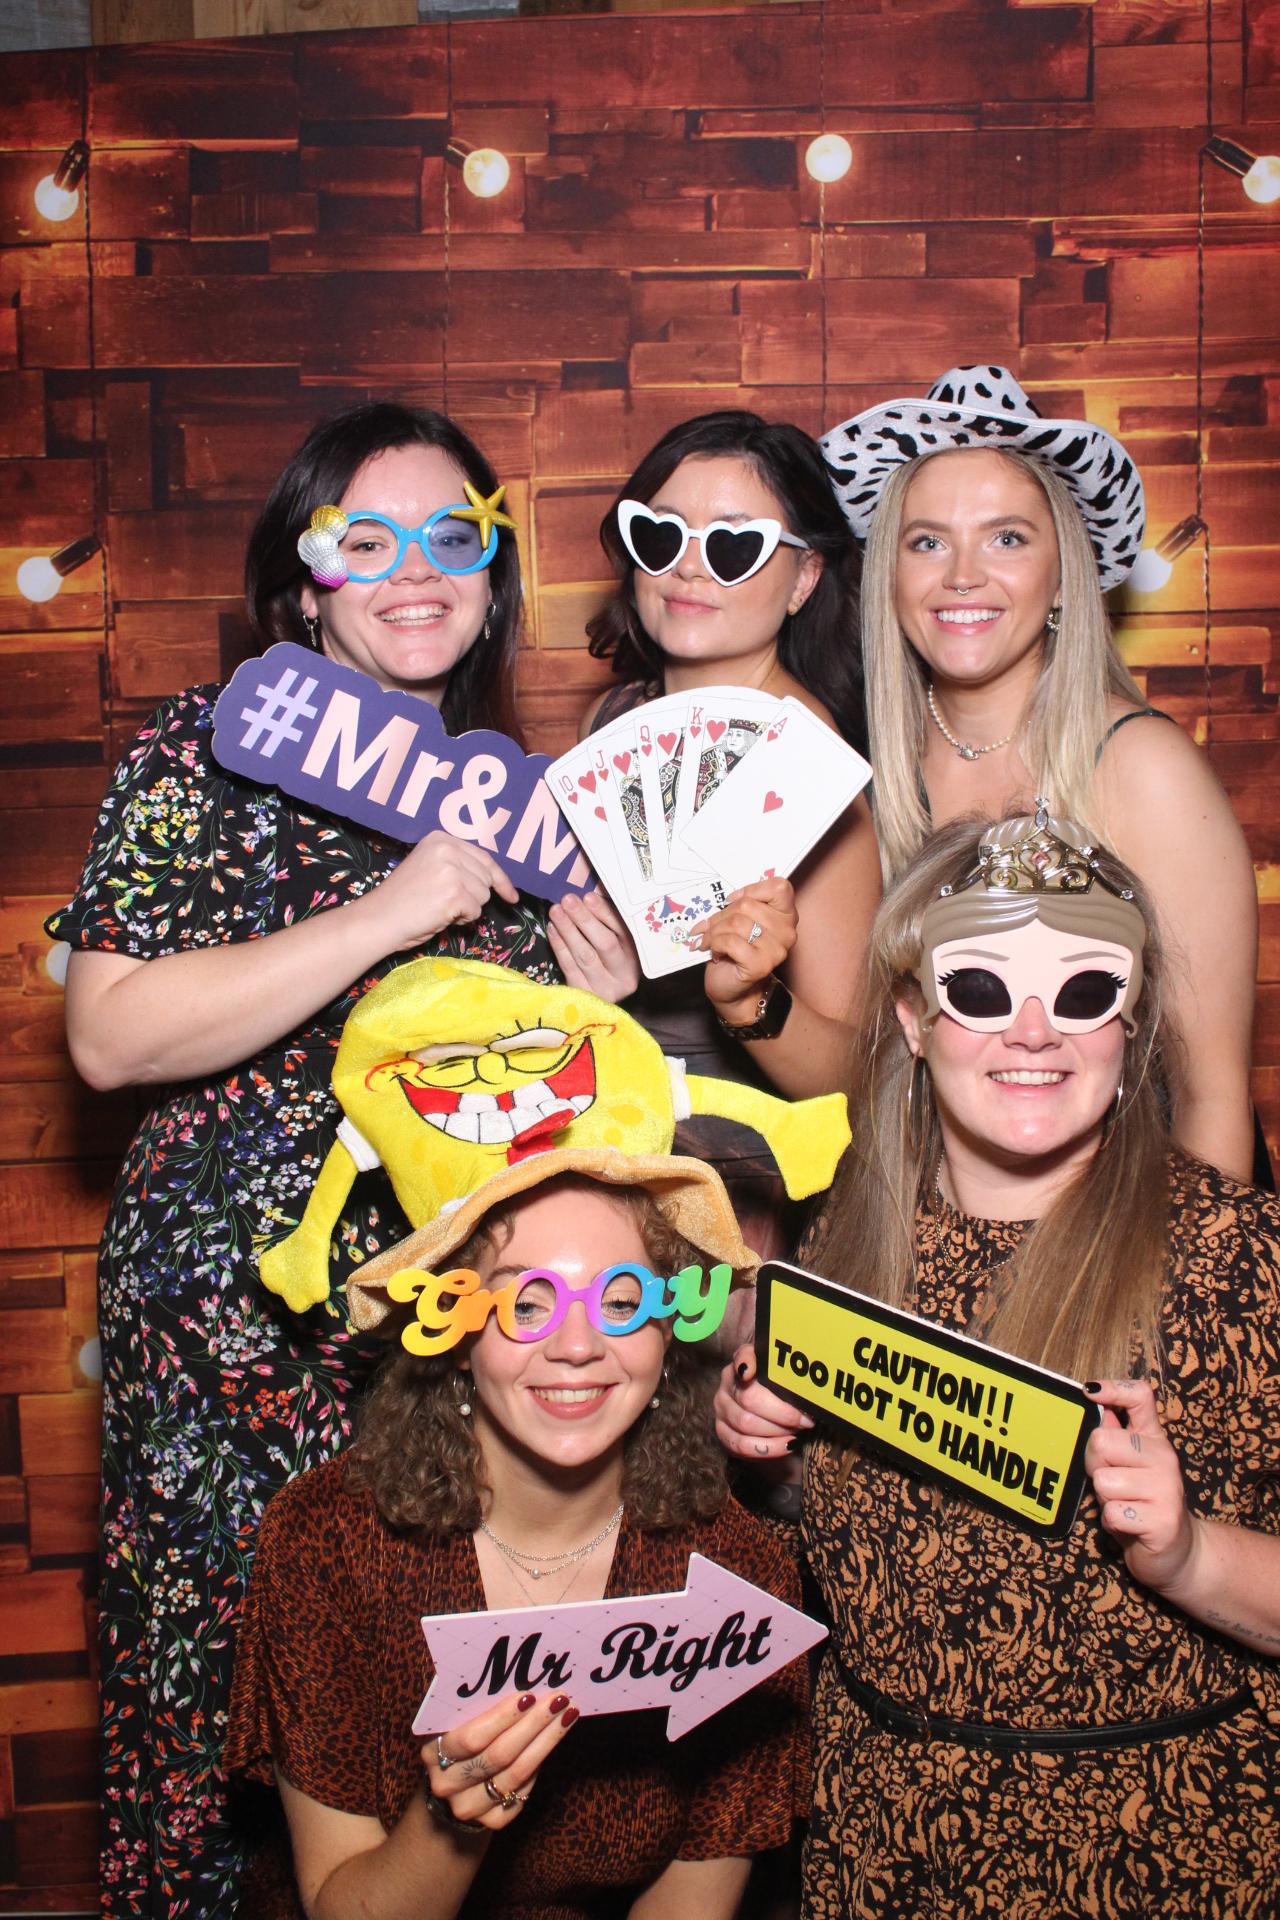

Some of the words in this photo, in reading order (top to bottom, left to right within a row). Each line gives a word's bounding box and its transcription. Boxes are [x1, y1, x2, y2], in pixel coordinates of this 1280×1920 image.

[690, 706, 705, 725] K
[773, 716, 789, 734] A
[639, 724, 652, 743] Q
[595, 750, 605, 769] J
[557, 774, 574, 794] 10
[853, 1336, 1014, 1437] CAUTION!!
[774, 1338, 830, 1388] TOO
[833, 1374, 893, 1421] HOT
[897, 1398, 935, 1443] TO
[938, 1419, 1061, 1512] HANDLE
[456, 1631, 573, 1699] Mr
[589, 1610, 773, 1694] Right
